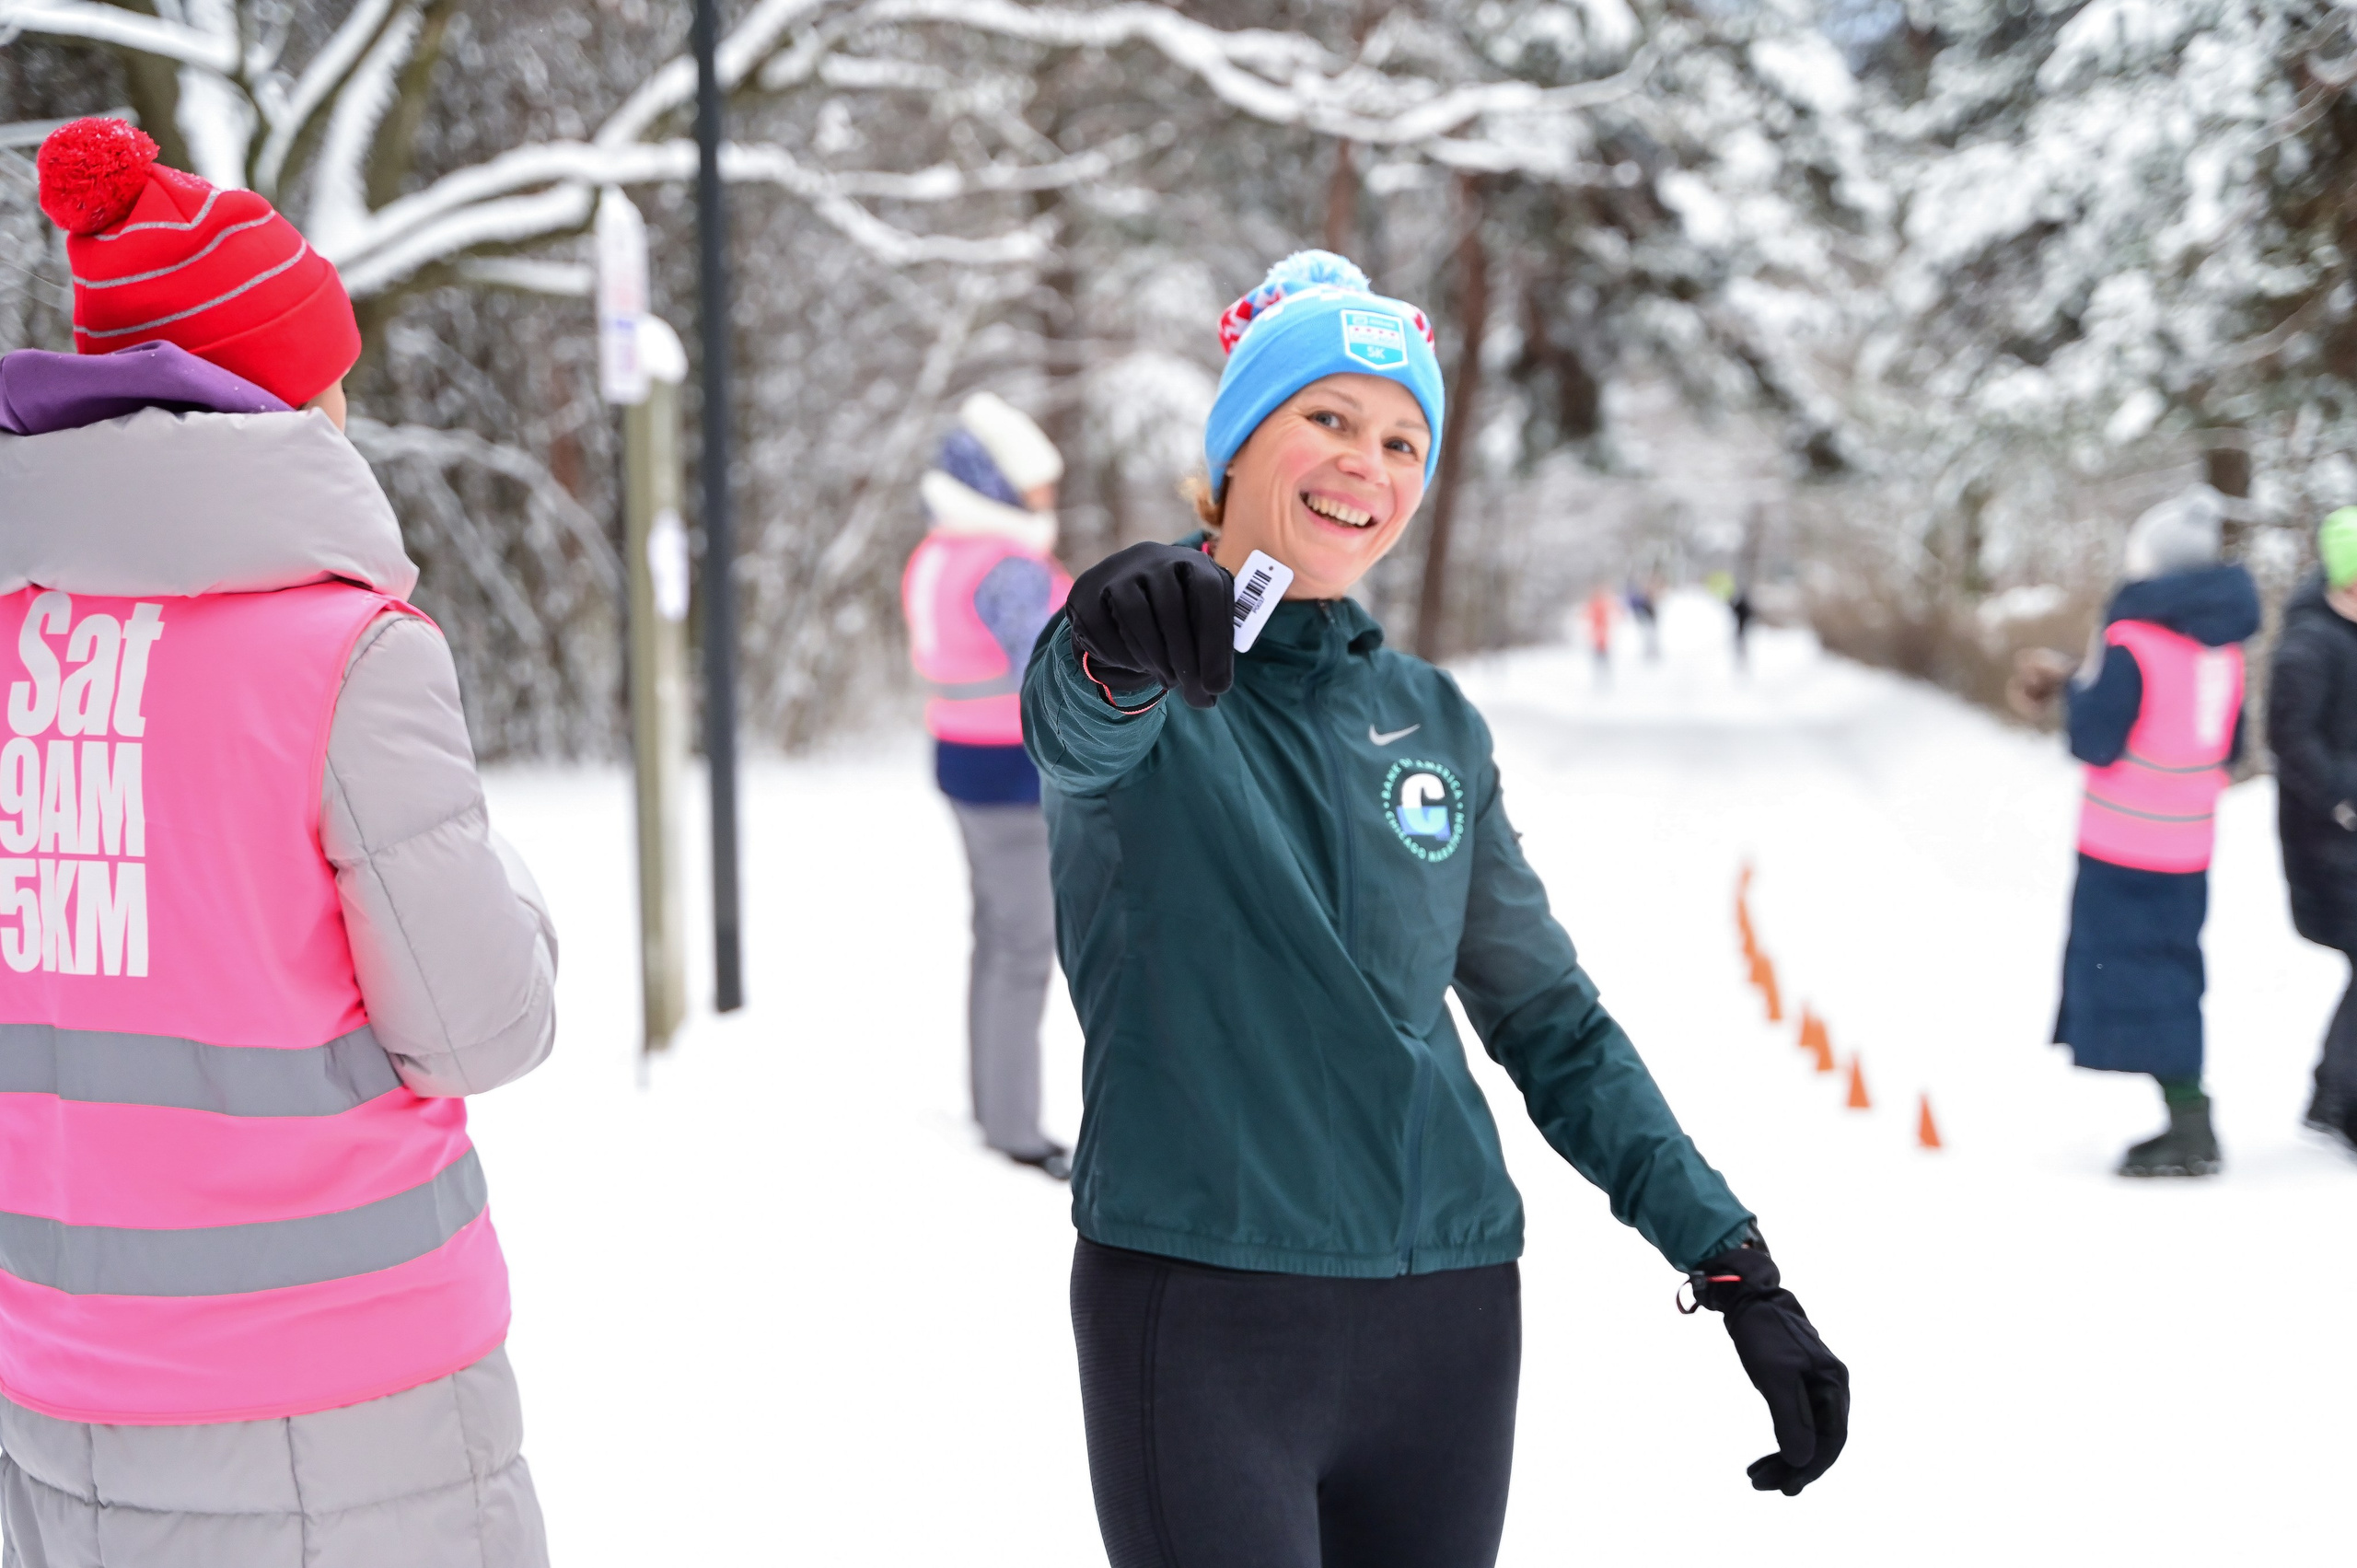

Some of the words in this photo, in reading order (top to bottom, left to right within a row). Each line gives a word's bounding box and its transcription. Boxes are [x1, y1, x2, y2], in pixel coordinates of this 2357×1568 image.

[7, 591, 165, 738] Sat
[0, 738, 145, 857] 9AM
[0, 857, 148, 978] 5KM
